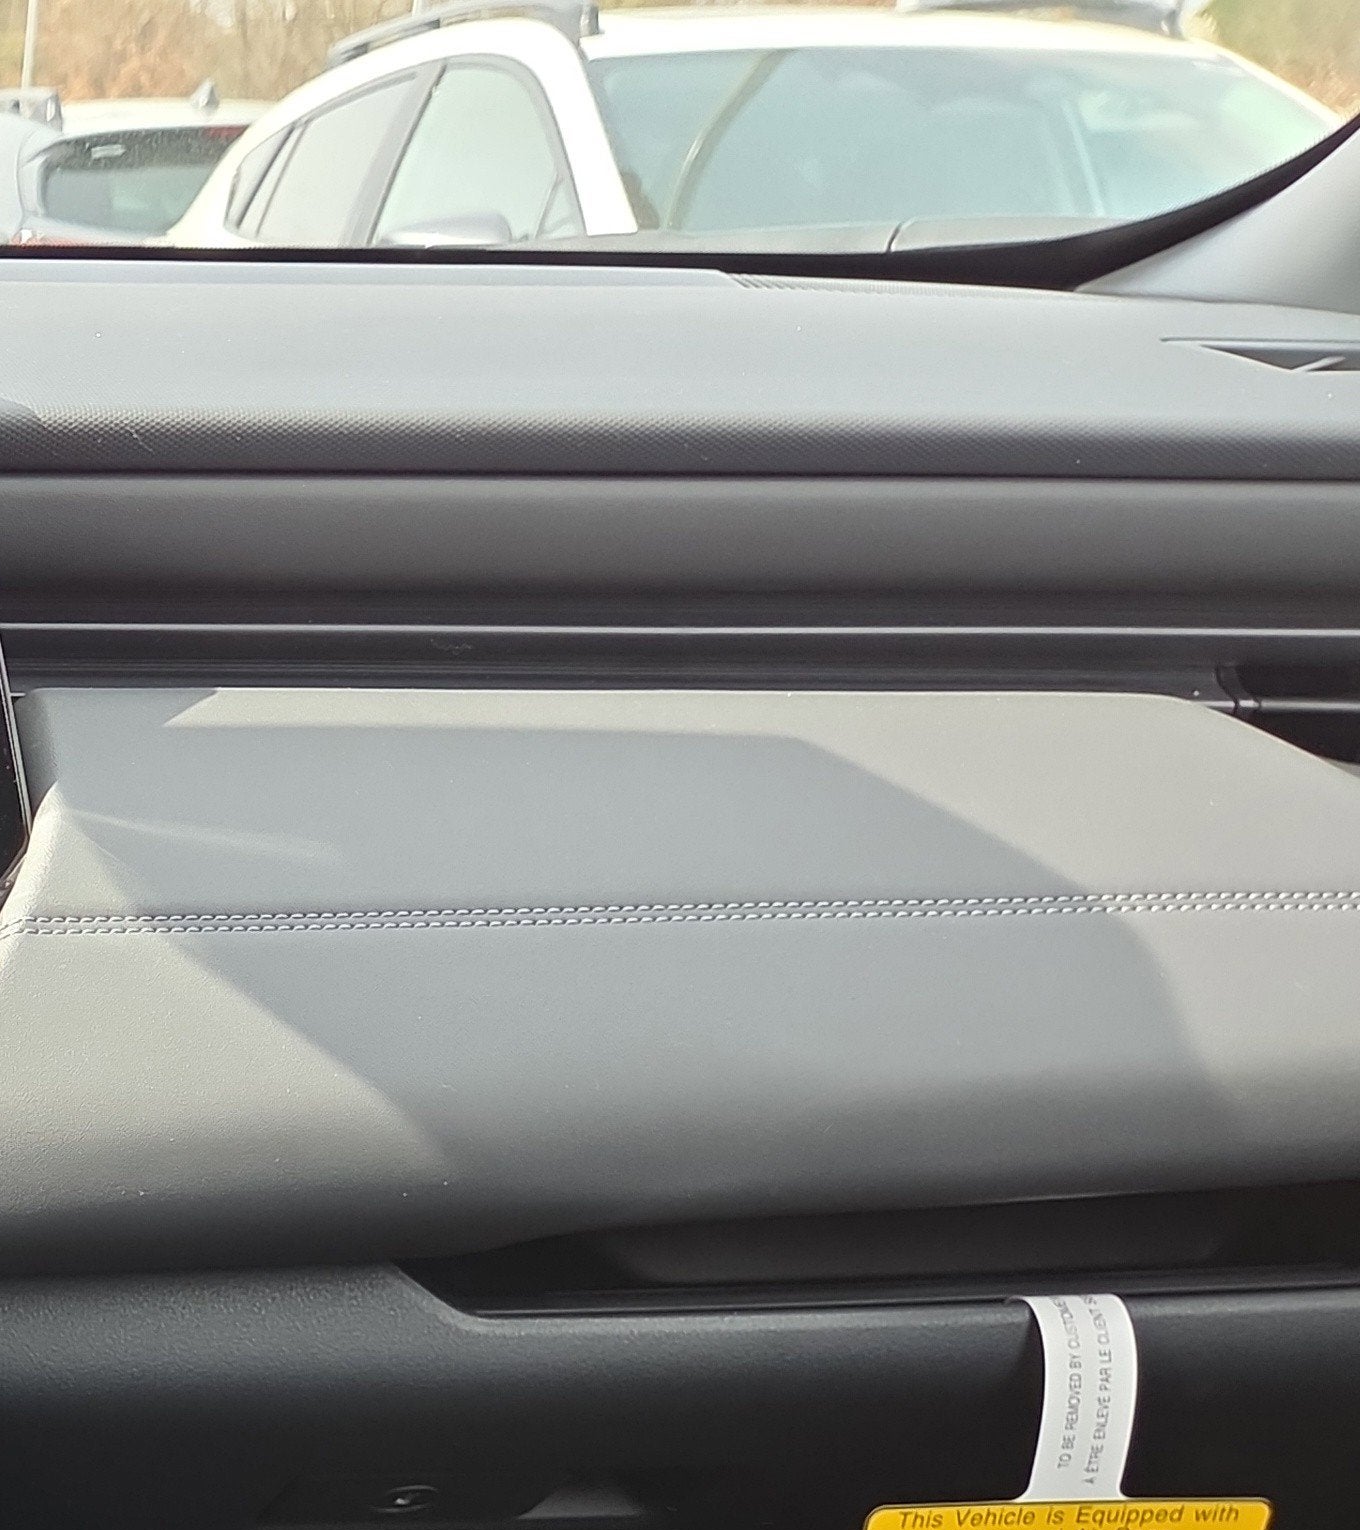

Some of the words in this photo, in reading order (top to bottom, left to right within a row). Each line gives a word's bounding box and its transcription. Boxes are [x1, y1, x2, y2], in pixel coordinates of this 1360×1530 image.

[1099, 1349, 1112, 1364] LE
[1061, 1434, 1077, 1450] BE
[1056, 1452, 1073, 1470] TO
[899, 1510, 944, 1530] This
[956, 1507, 1035, 1528] Vehicle
[1046, 1505, 1065, 1525] is
[1075, 1504, 1184, 1528] Equipped
[1194, 1504, 1240, 1523] with
